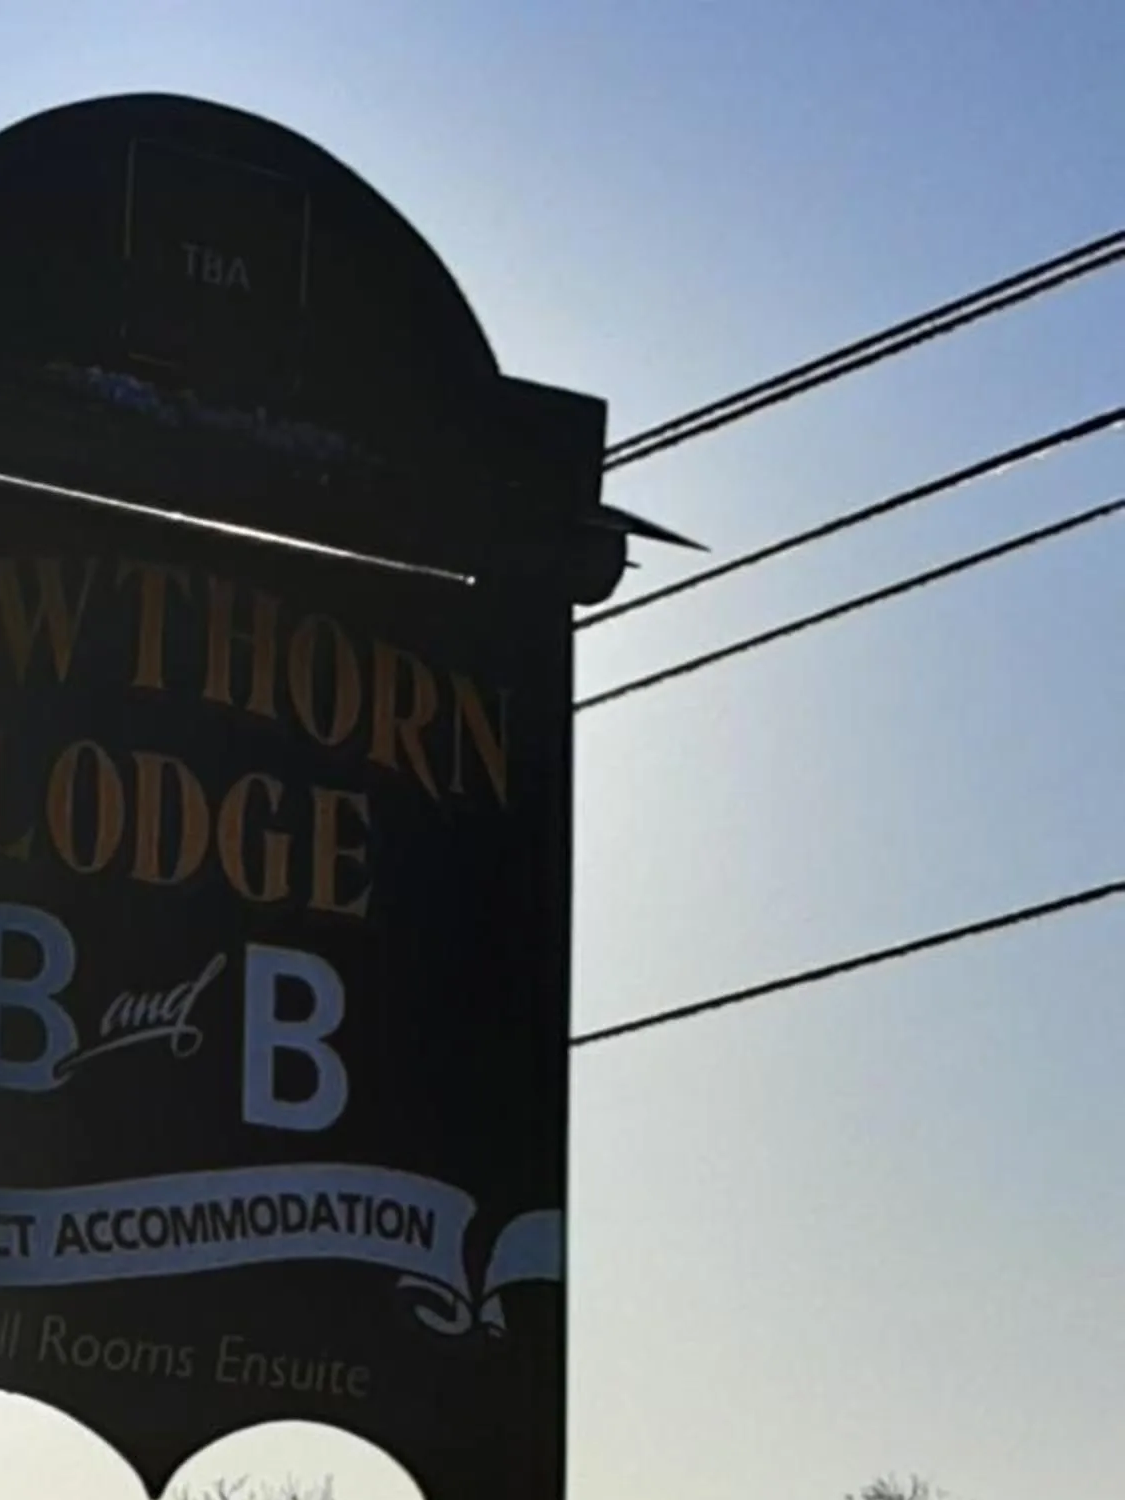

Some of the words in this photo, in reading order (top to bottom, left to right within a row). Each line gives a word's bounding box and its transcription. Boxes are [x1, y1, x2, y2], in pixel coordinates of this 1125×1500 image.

[181, 240, 251, 292] TBA
[53, 952, 227, 1083] and
[241, 942, 349, 1132] B
[53, 1192, 436, 1257] ACCOMMODATION
[38, 1315, 195, 1379] Rooms
[215, 1335, 371, 1399] Ensuite
